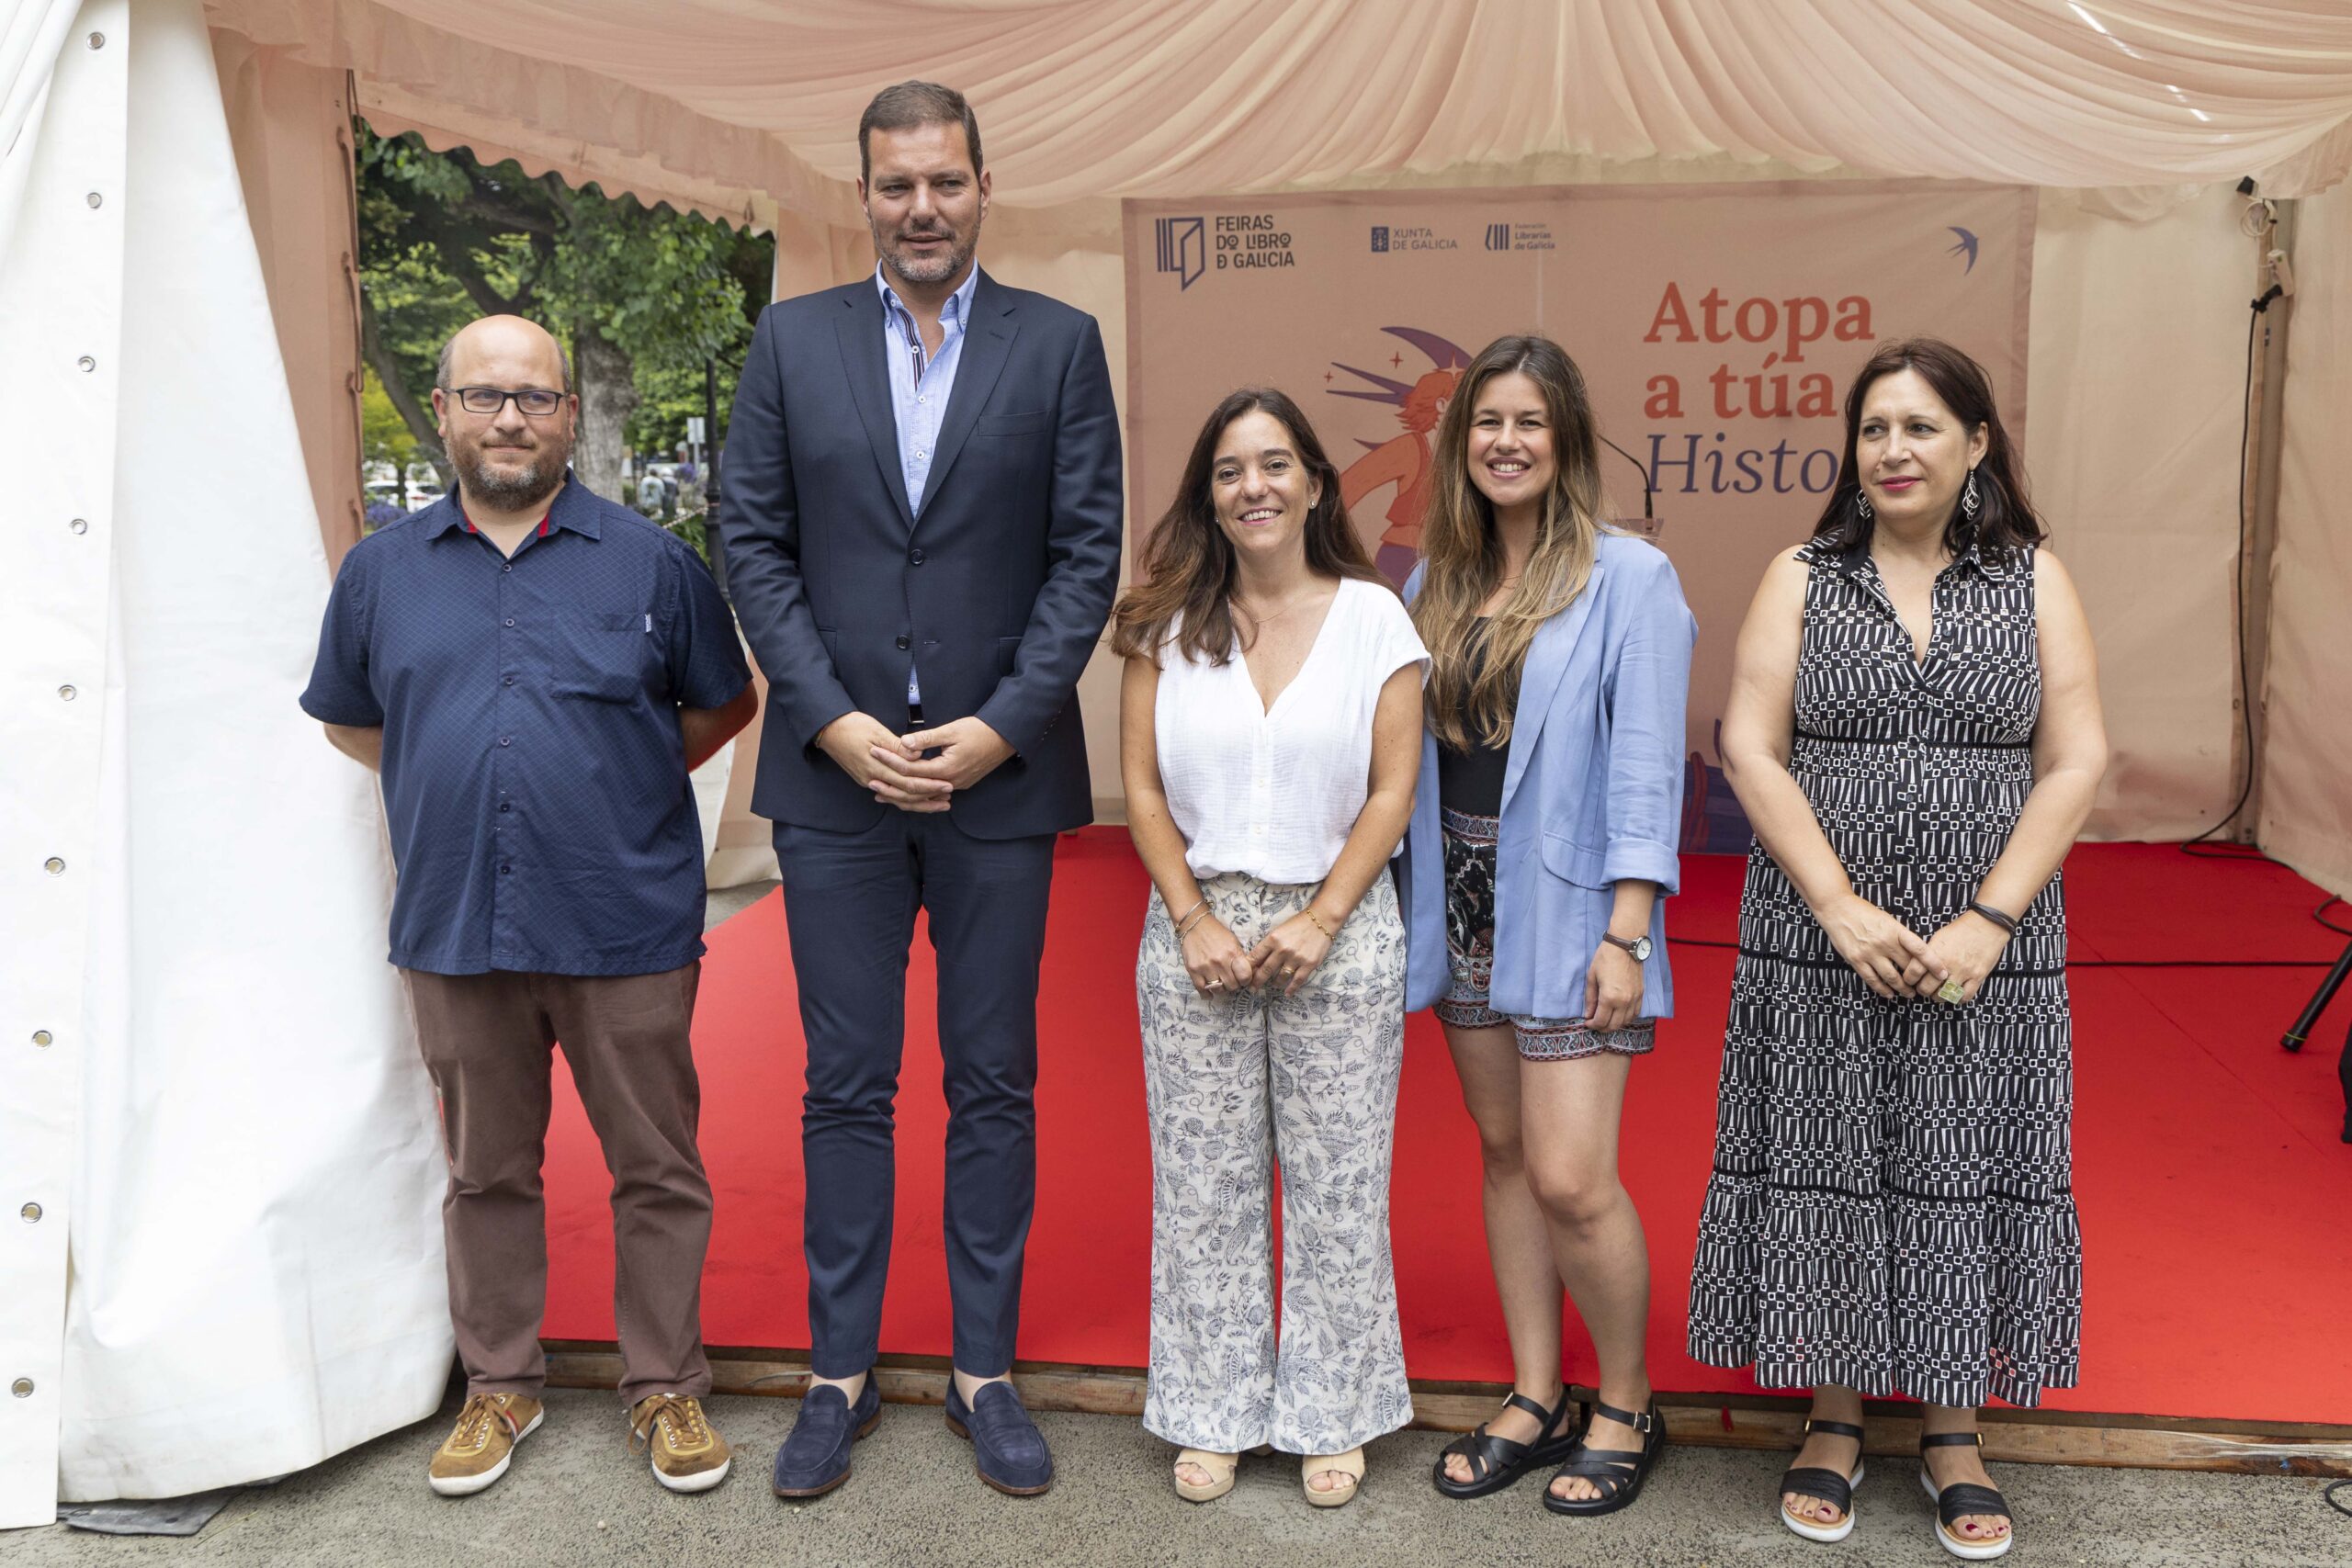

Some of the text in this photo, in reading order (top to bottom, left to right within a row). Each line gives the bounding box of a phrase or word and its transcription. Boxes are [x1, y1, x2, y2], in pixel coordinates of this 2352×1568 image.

[1216, 214, 1274, 231] FEIRAS
[1246, 232, 1292, 250] LIBRO
[1393, 227, 1433, 238] XUNTA
[1393, 239, 1458, 250] DE GALICIA
[1514, 241, 1555, 250] de Galicia
[1233, 251, 1295, 269] GALICIA
[1644, 281, 1875, 363] Atopa
[1644, 352, 1838, 419] a túa
[1643, 432, 1838, 494] Histo
